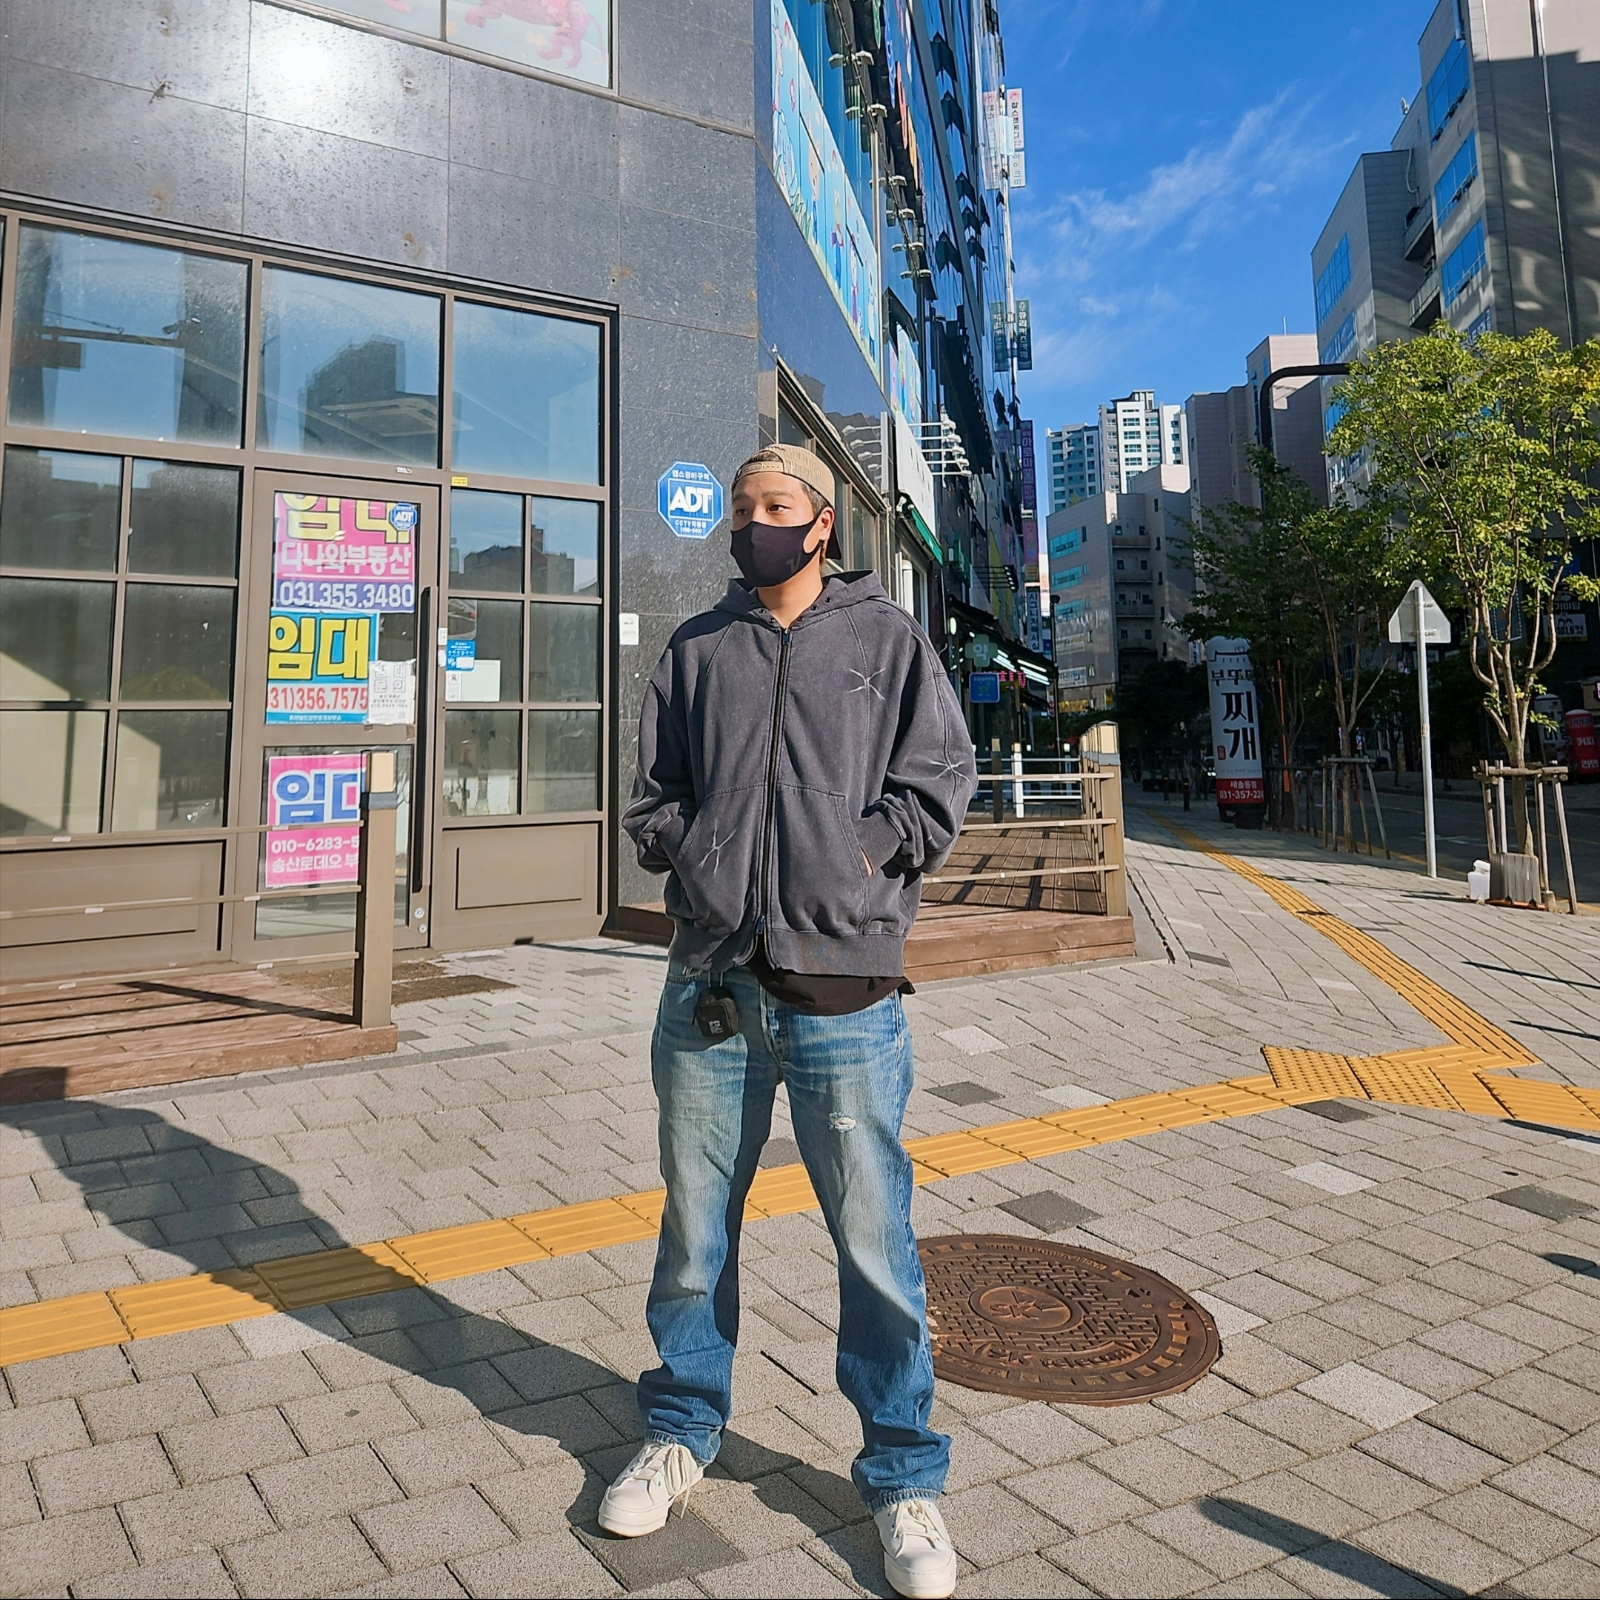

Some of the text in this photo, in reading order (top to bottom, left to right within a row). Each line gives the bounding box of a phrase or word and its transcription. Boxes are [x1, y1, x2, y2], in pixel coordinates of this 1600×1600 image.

[669, 486, 713, 514] ADT
[394, 511, 414, 523] ADT
[281, 540, 412, 577] 다나와부동산
[279, 581, 415, 608] 031.355.3480
[1029, 593, 1041, 651] 시그니처독서실
[267, 616, 370, 680] 임대
[973, 644, 989, 661] 약
[1221, 691, 1257, 761] 찌개
[271, 854, 343, 875] 송산로데오
[987, 1347, 1034, 1366] SK
